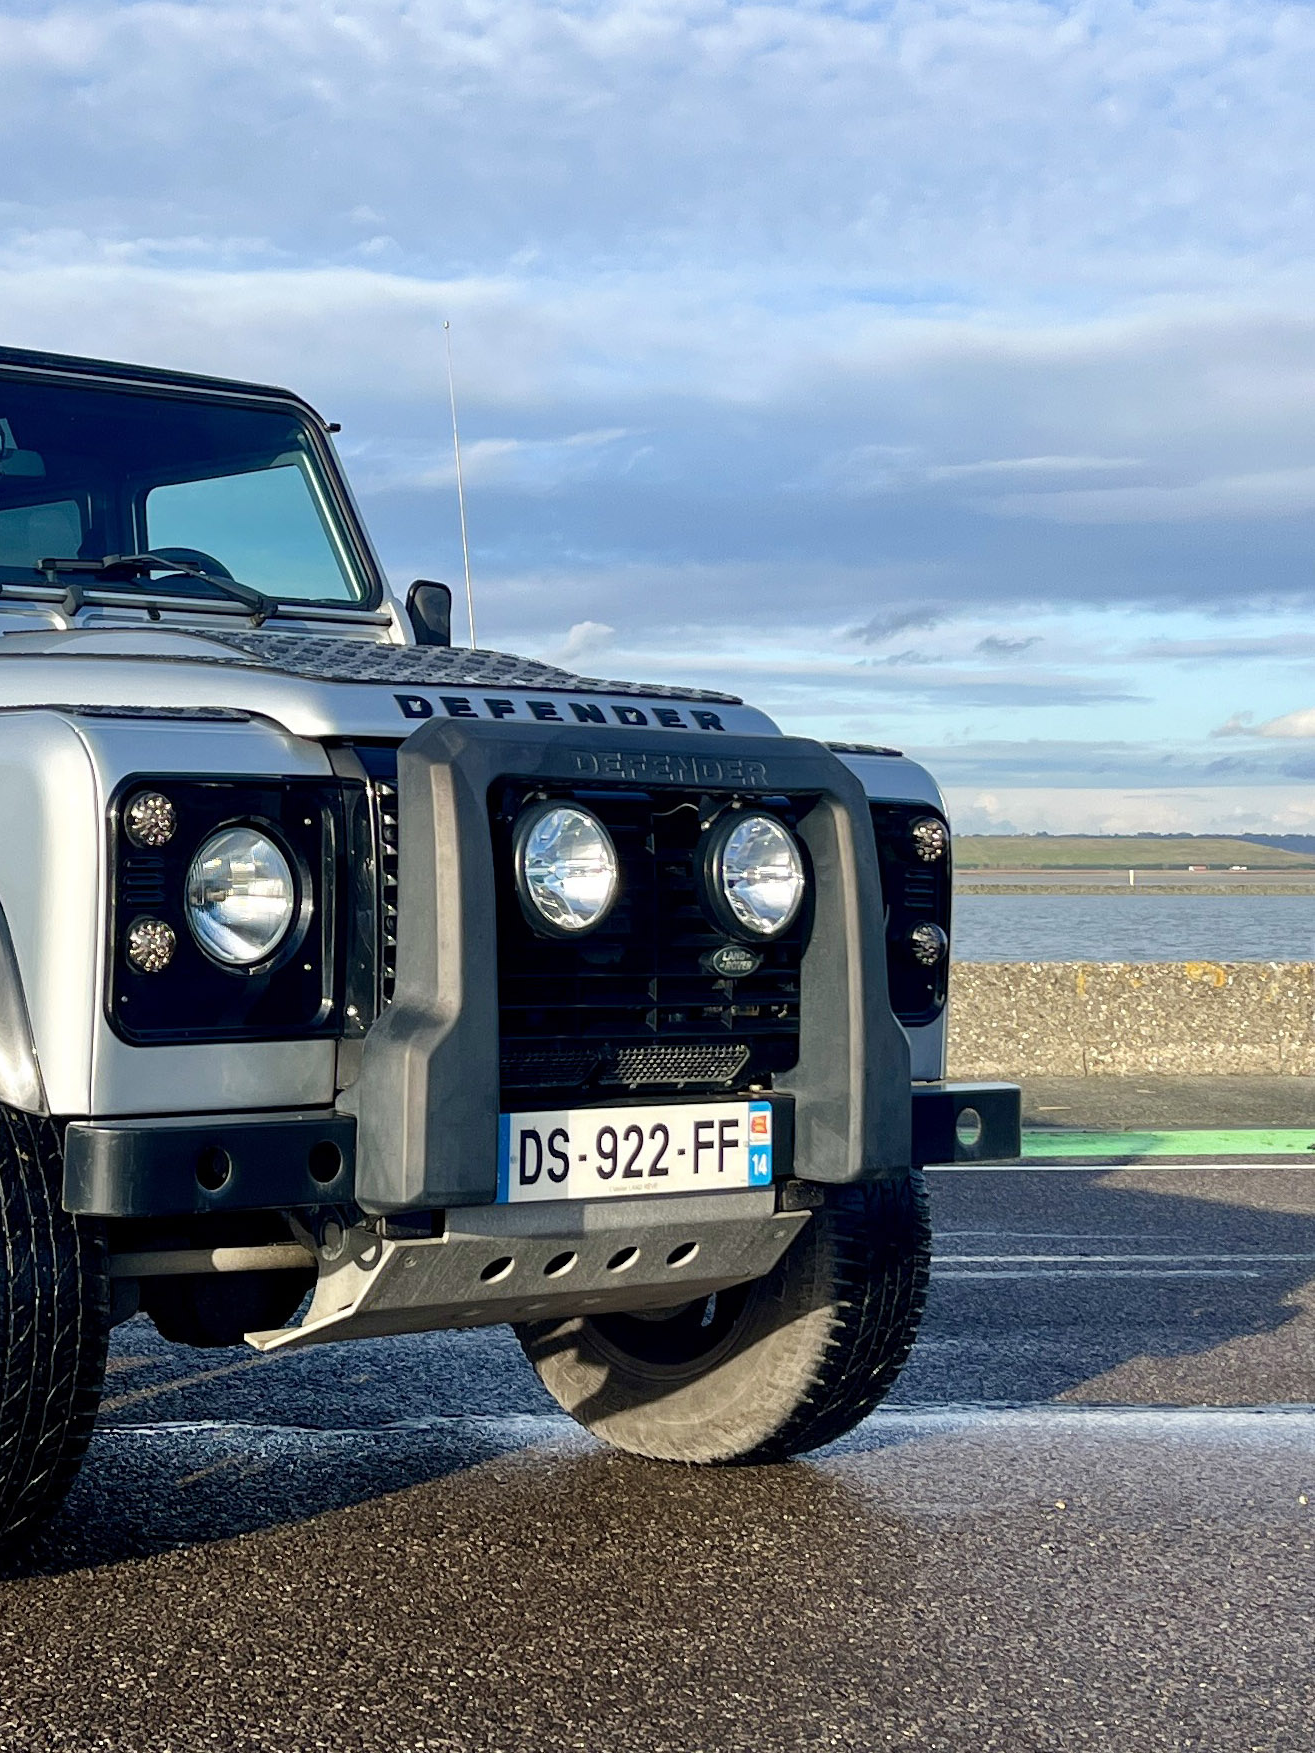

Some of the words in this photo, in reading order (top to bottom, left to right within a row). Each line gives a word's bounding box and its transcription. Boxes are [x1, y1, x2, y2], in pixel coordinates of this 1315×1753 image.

[394, 694, 726, 731] DEFENDER
[576, 751, 768, 786] DEFENDER
[520, 1119, 739, 1185] DS-922-FF
[752, 1153, 768, 1177] 14
